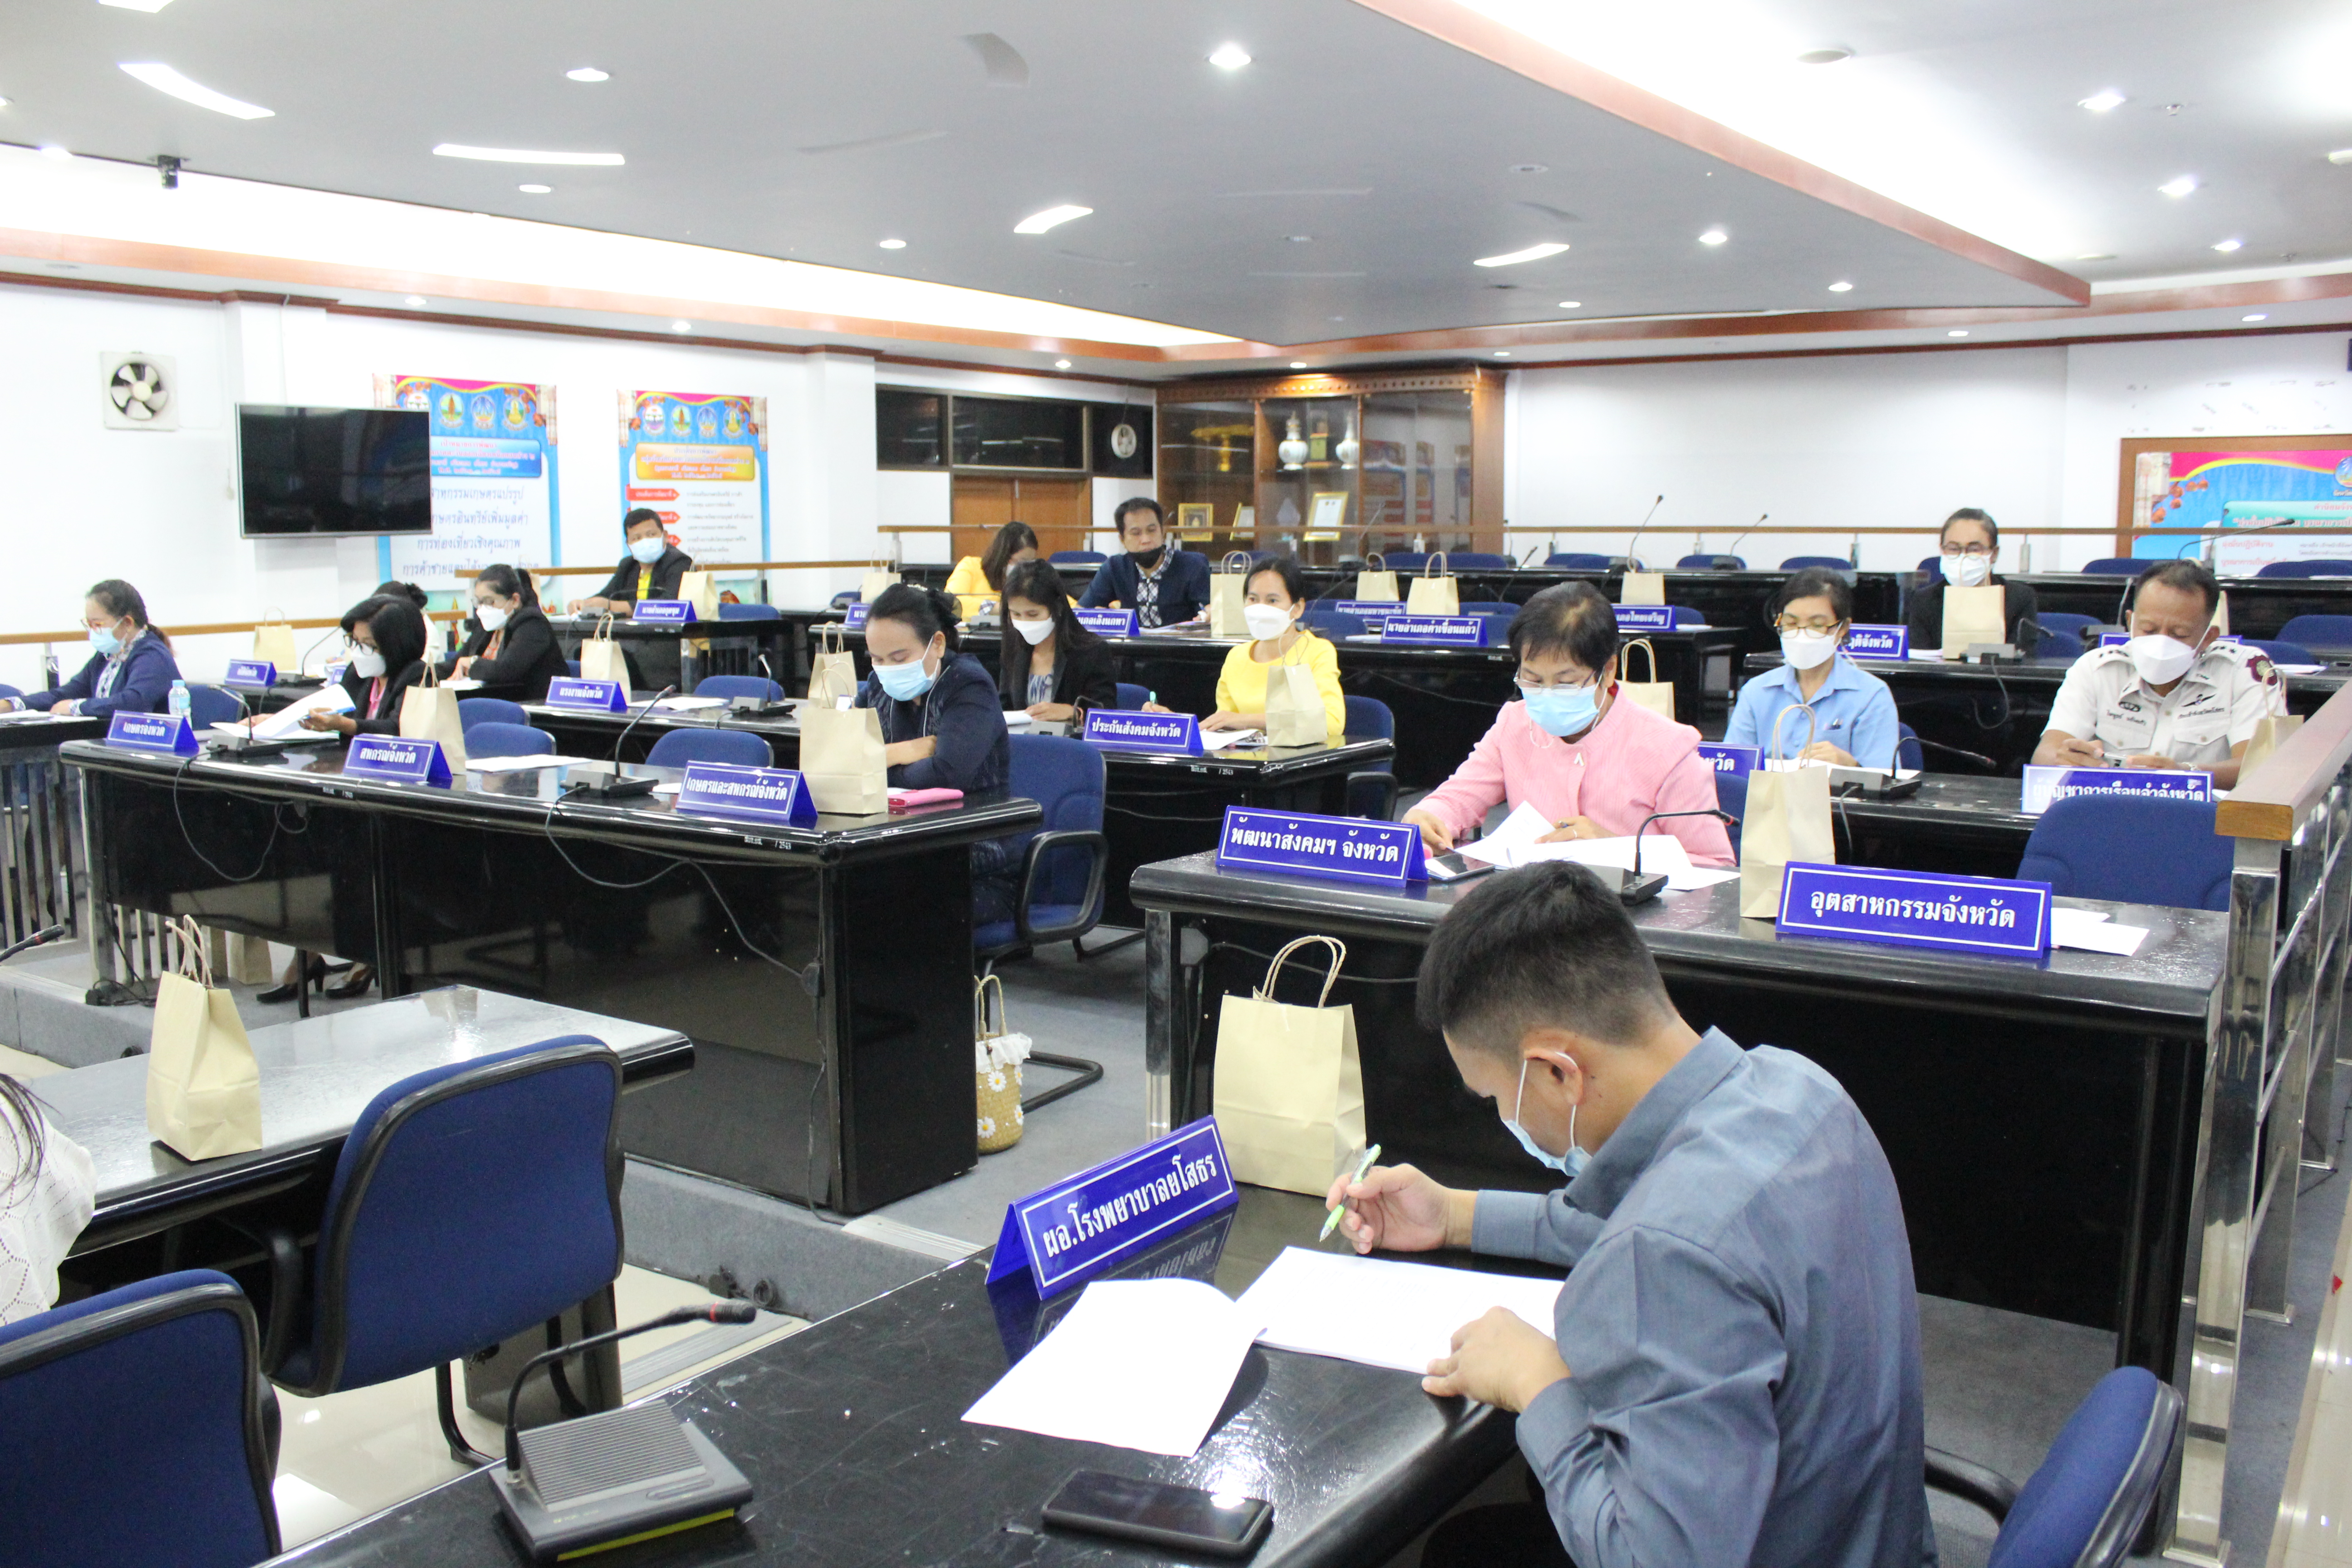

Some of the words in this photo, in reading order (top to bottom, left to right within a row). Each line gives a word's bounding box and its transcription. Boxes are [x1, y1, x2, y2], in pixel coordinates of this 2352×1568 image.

[559, 686, 603, 699] แรงงานจังหวัด
[123, 719, 166, 737] เกษตรจังหวัด
[1092, 717, 1181, 738] ประกันสังคมจังหวัด
[360, 743, 416, 764] สหกรณ์จังหวัด
[686, 777, 788, 801] เกษตรและสหกรณ์จังหวัด
[1230, 816, 1337, 856] พัฒนาสังคมฯ
[1342, 829, 1399, 862] จังหวัด
[1810, 891, 2016, 928] อุตสาหกรรมจังหวัด
[1042, 1153, 1218, 1258] ผอ.โรงพยาบาลยโสธร
